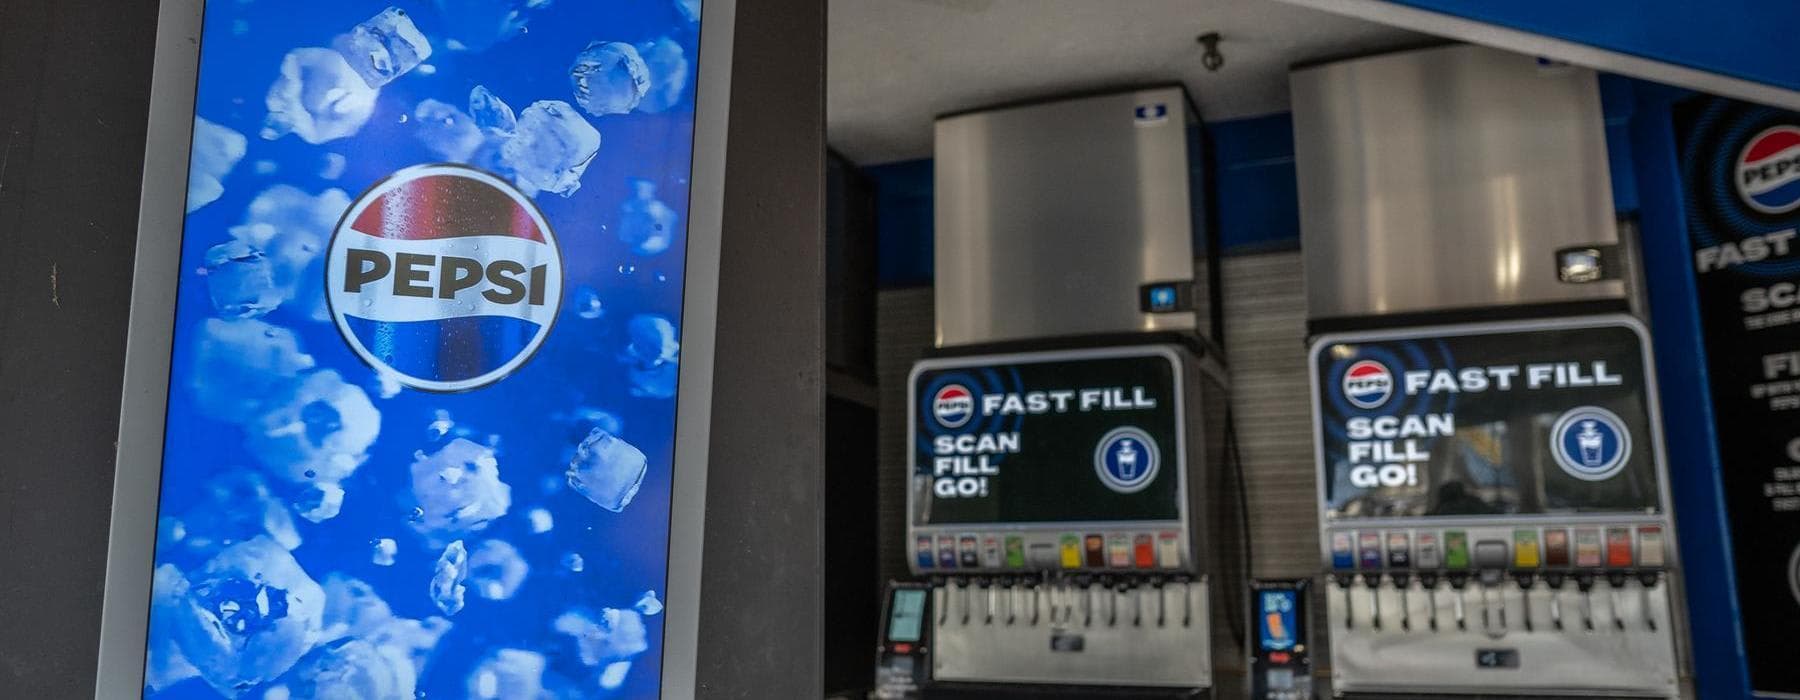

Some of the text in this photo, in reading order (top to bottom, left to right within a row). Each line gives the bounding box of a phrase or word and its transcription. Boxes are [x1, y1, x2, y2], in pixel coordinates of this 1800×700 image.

[1696, 228, 1797, 273] FAST
[343, 247, 548, 306] PEPSI
[1740, 282, 1800, 313] SC
[1347, 378, 1389, 389] PEPSI
[1404, 360, 1623, 394] FAST FILL
[983, 387, 1155, 415] FAST FILL
[1347, 414, 1454, 438] SCAN
[935, 433, 1020, 454] SCAN
[1348, 440, 1430, 463] FILL
[934, 456, 999, 477] FILL
[1350, 464, 1417, 488] GO!
[935, 478, 987, 497] GO!
